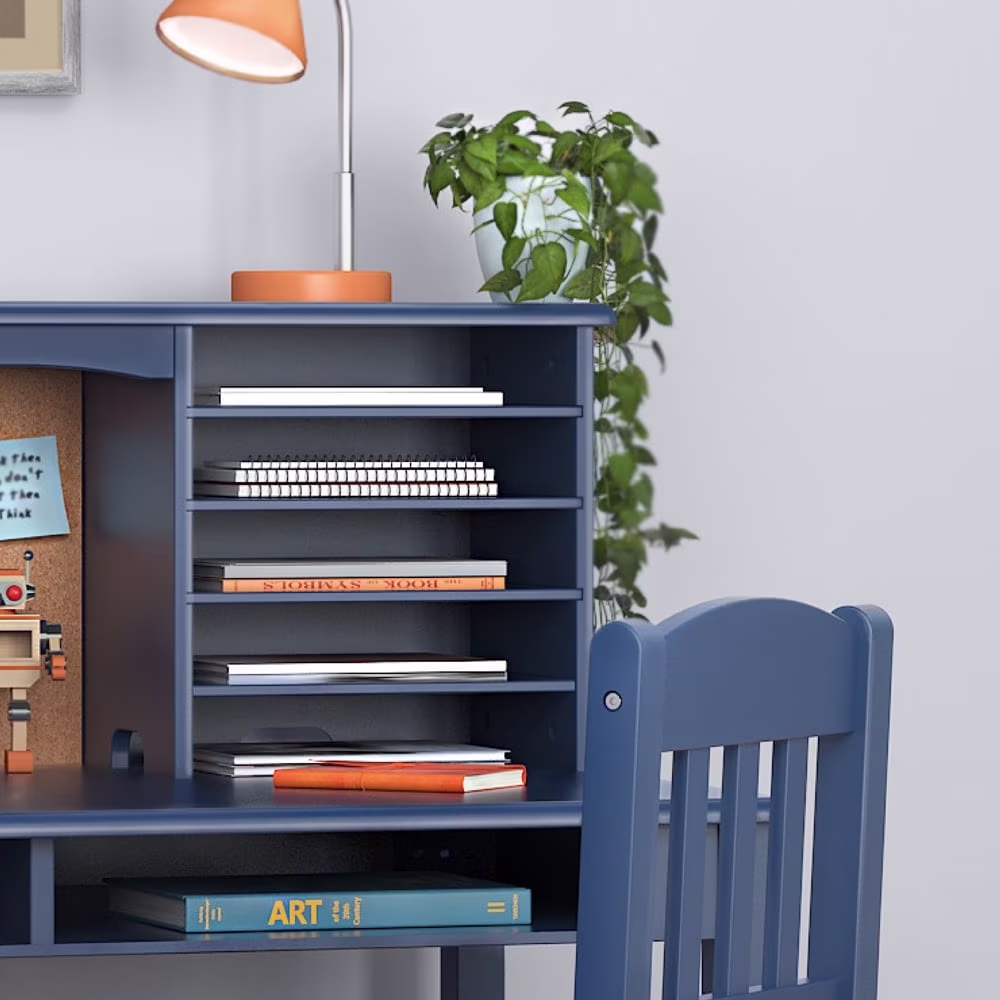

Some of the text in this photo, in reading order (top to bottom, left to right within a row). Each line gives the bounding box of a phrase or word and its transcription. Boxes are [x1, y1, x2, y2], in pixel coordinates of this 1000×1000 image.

[263, 580, 361, 591] SYMBOLS
[384, 579, 439, 589] BOOK
[267, 899, 323, 926] ART
